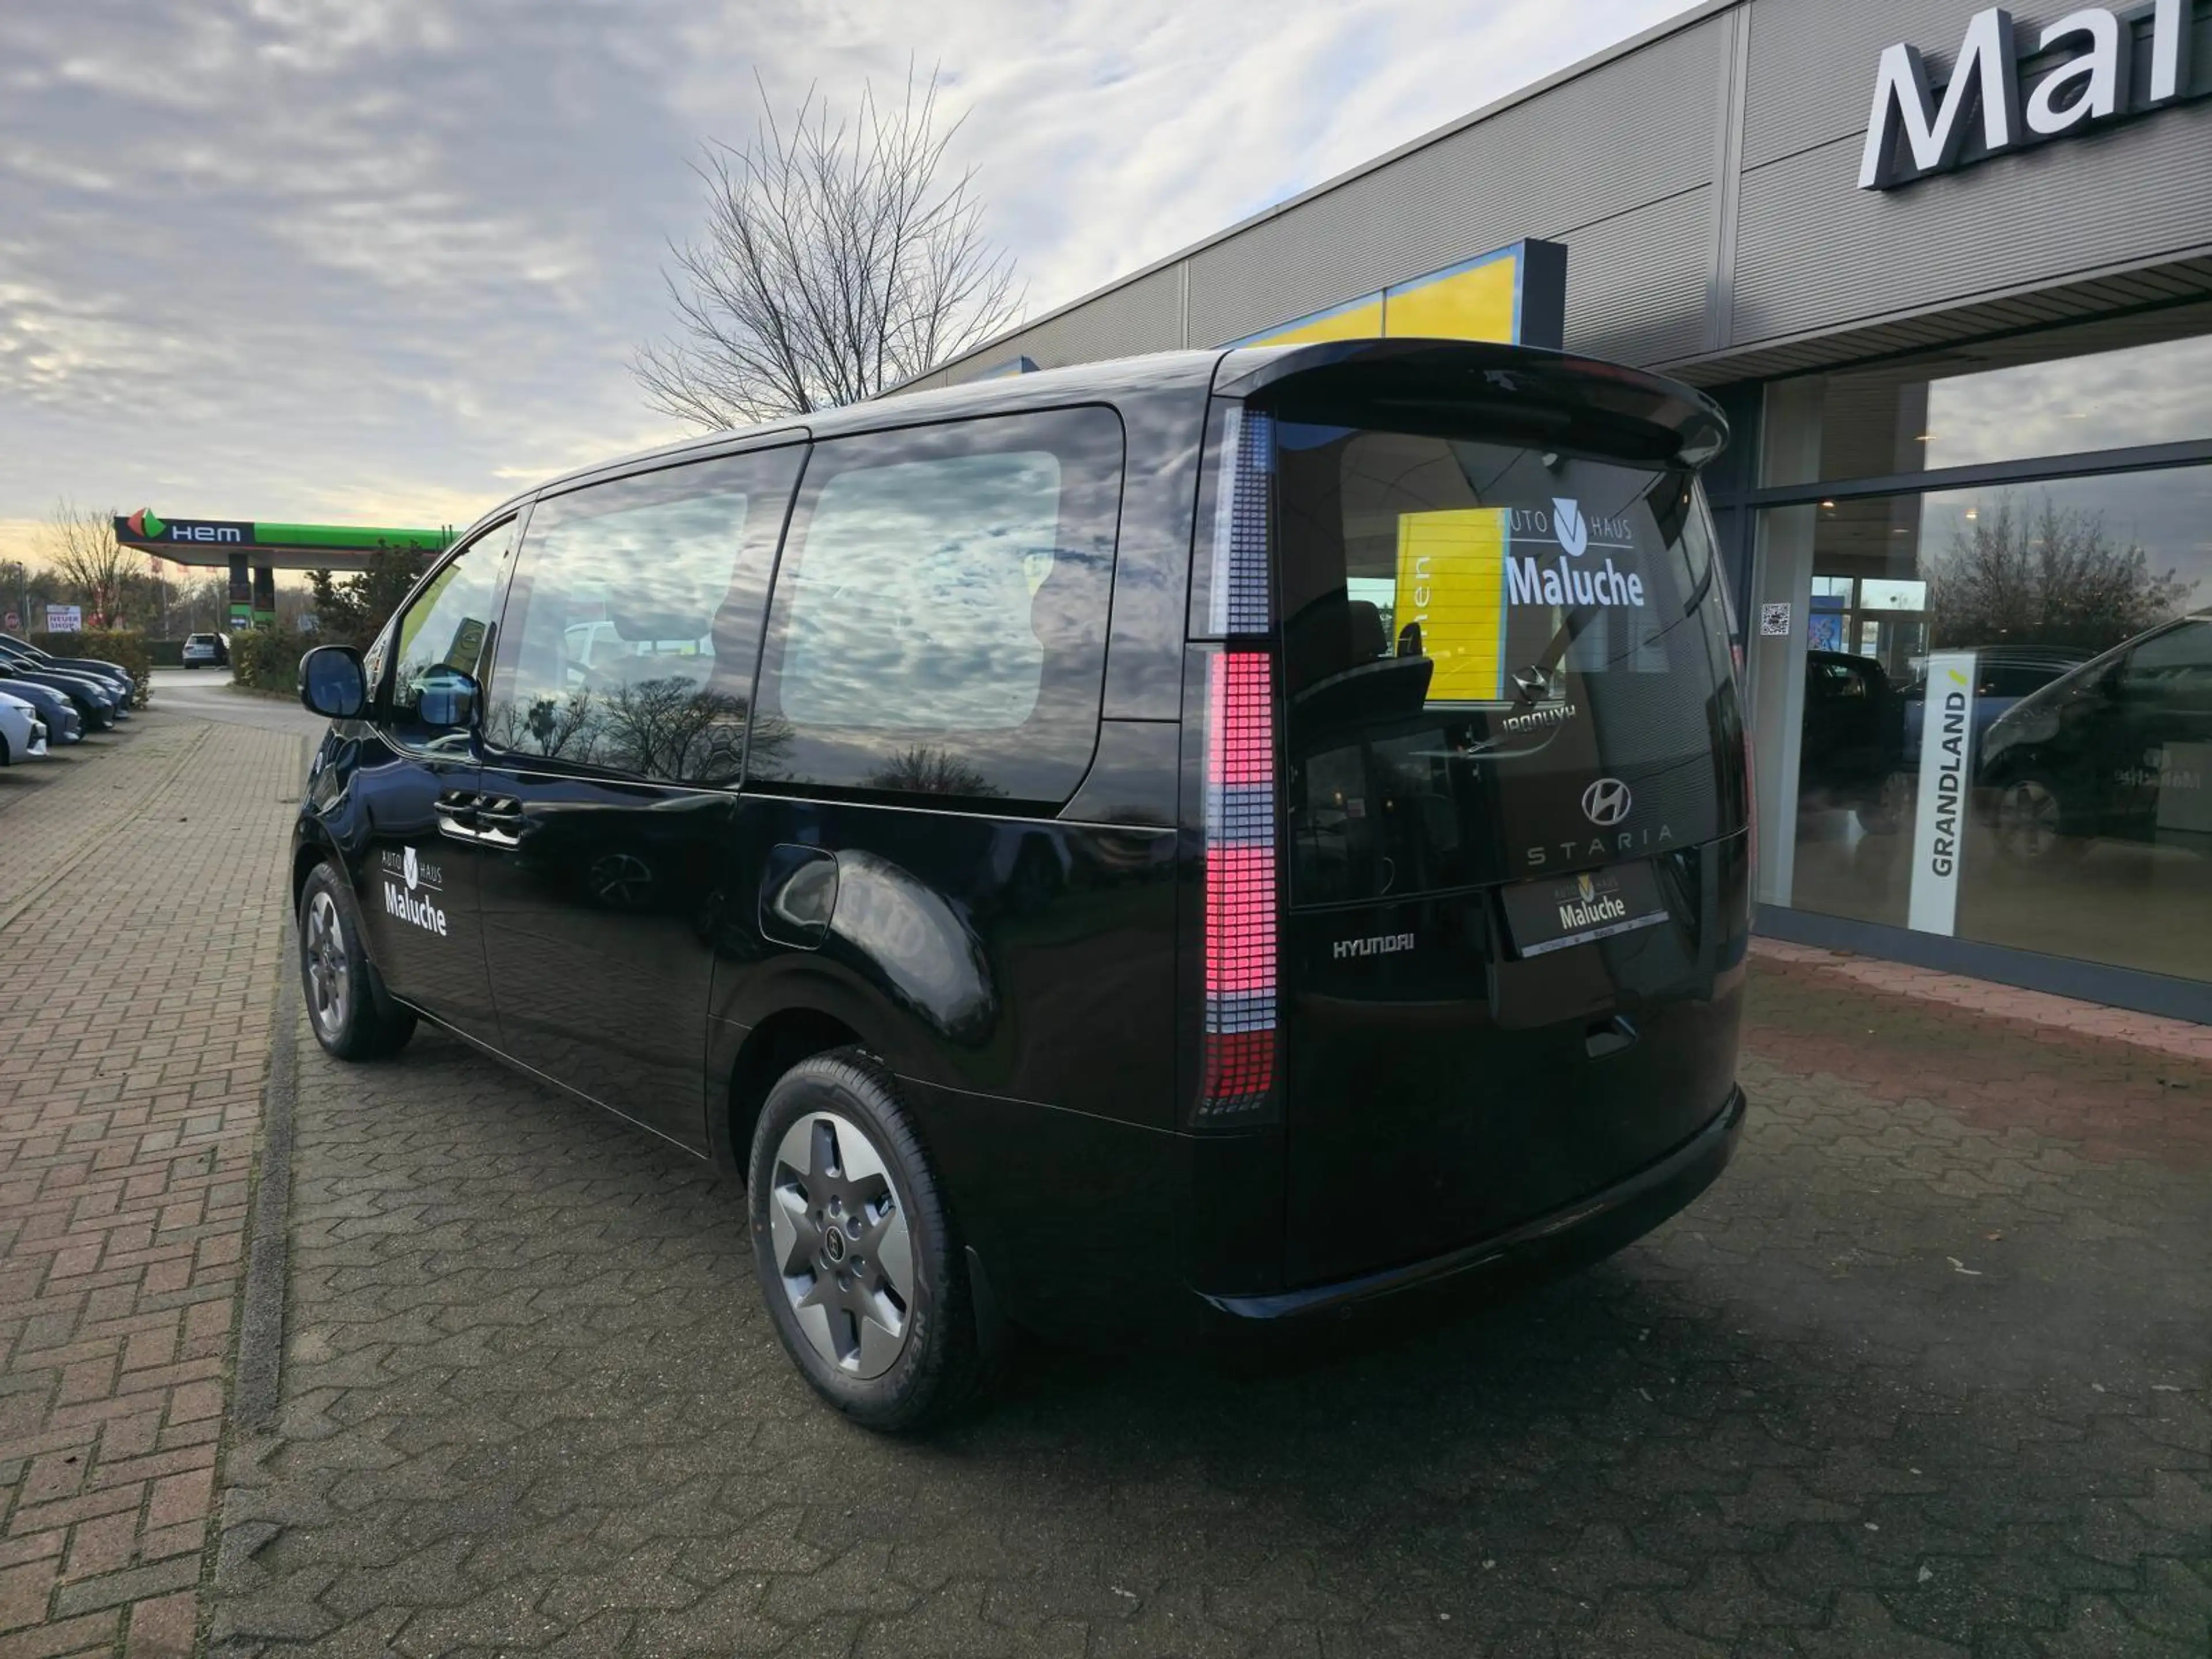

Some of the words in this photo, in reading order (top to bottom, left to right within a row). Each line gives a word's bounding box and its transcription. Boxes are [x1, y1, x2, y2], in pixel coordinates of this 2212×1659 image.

[1857, 0, 2181, 190] Mal
[1498, 509, 1548, 533] UTO
[1591, 515, 1633, 540] HAUS
[1506, 556, 1645, 607] Maluche
[1932, 692, 1966, 877] GRANDLAND
[1527, 824, 1672, 865] STARIA
[381, 850, 402, 870] AUTO
[419, 862, 443, 883] HAUS
[384, 881, 447, 937] Maluche
[1559, 896, 1626, 930] Maluche
[1333, 933, 1414, 959] HYUNDAI
